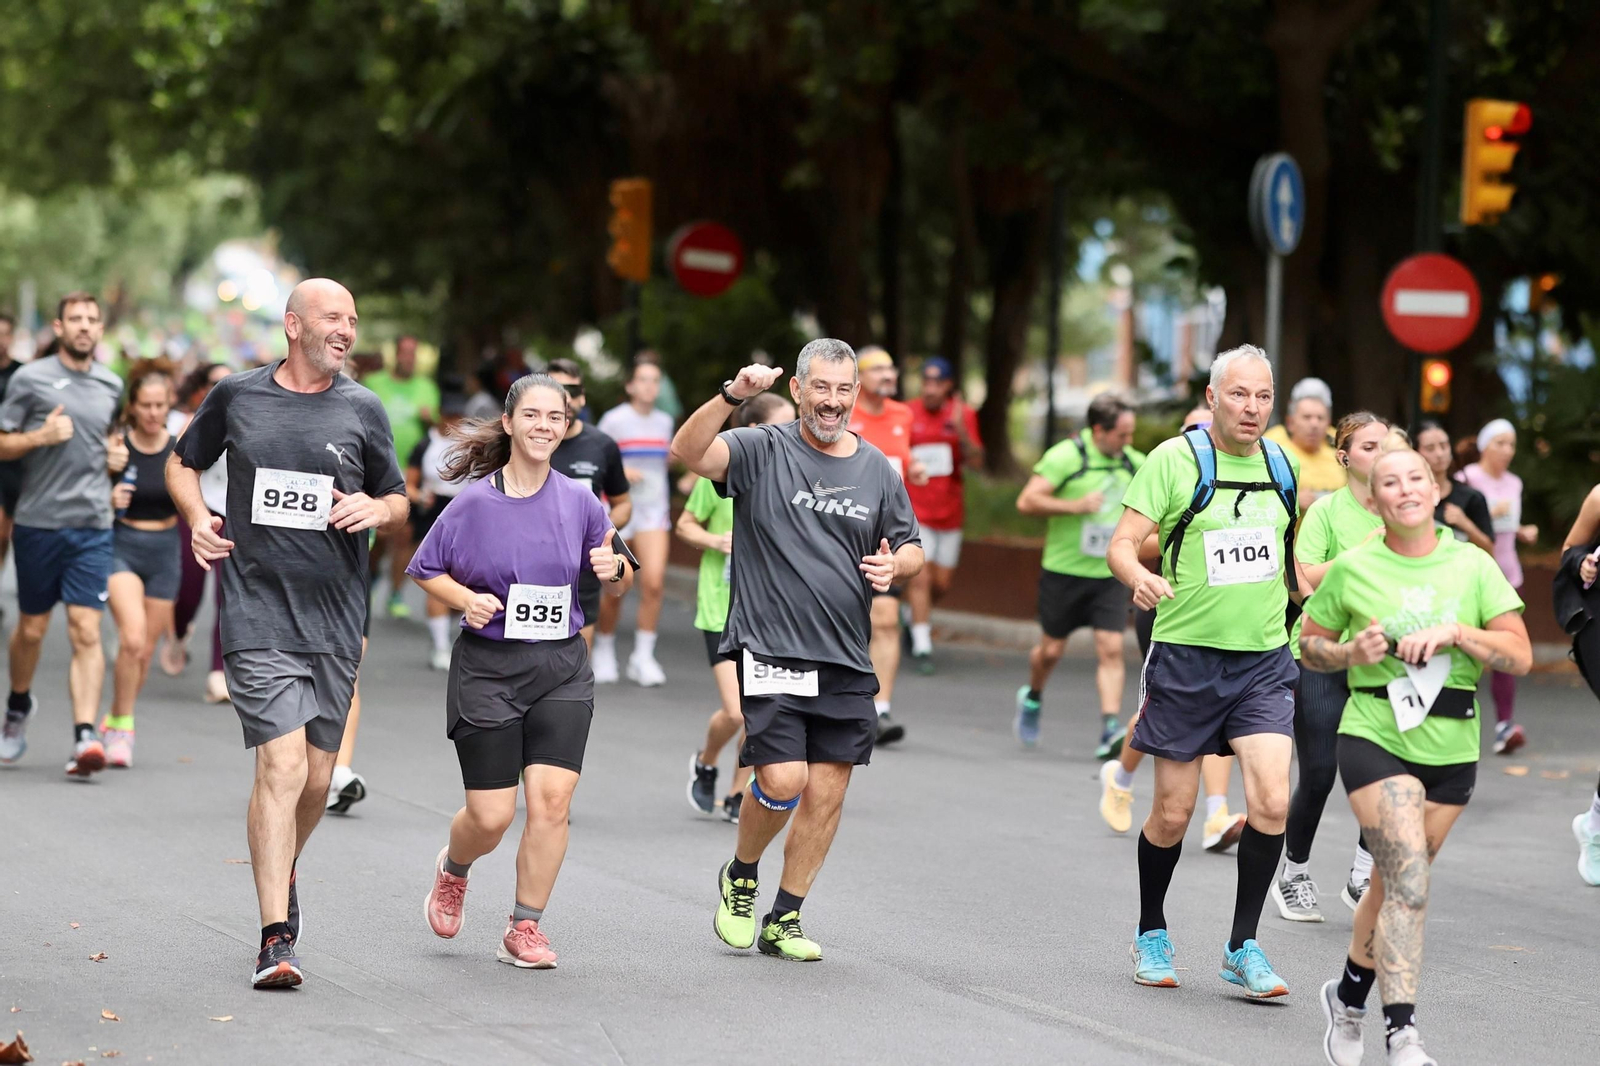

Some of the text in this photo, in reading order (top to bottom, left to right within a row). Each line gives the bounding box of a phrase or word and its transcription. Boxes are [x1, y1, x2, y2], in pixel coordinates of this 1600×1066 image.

[263, 488, 318, 512] 928
[1213, 545, 1270, 564] 1104
[515, 603, 563, 624] 935
